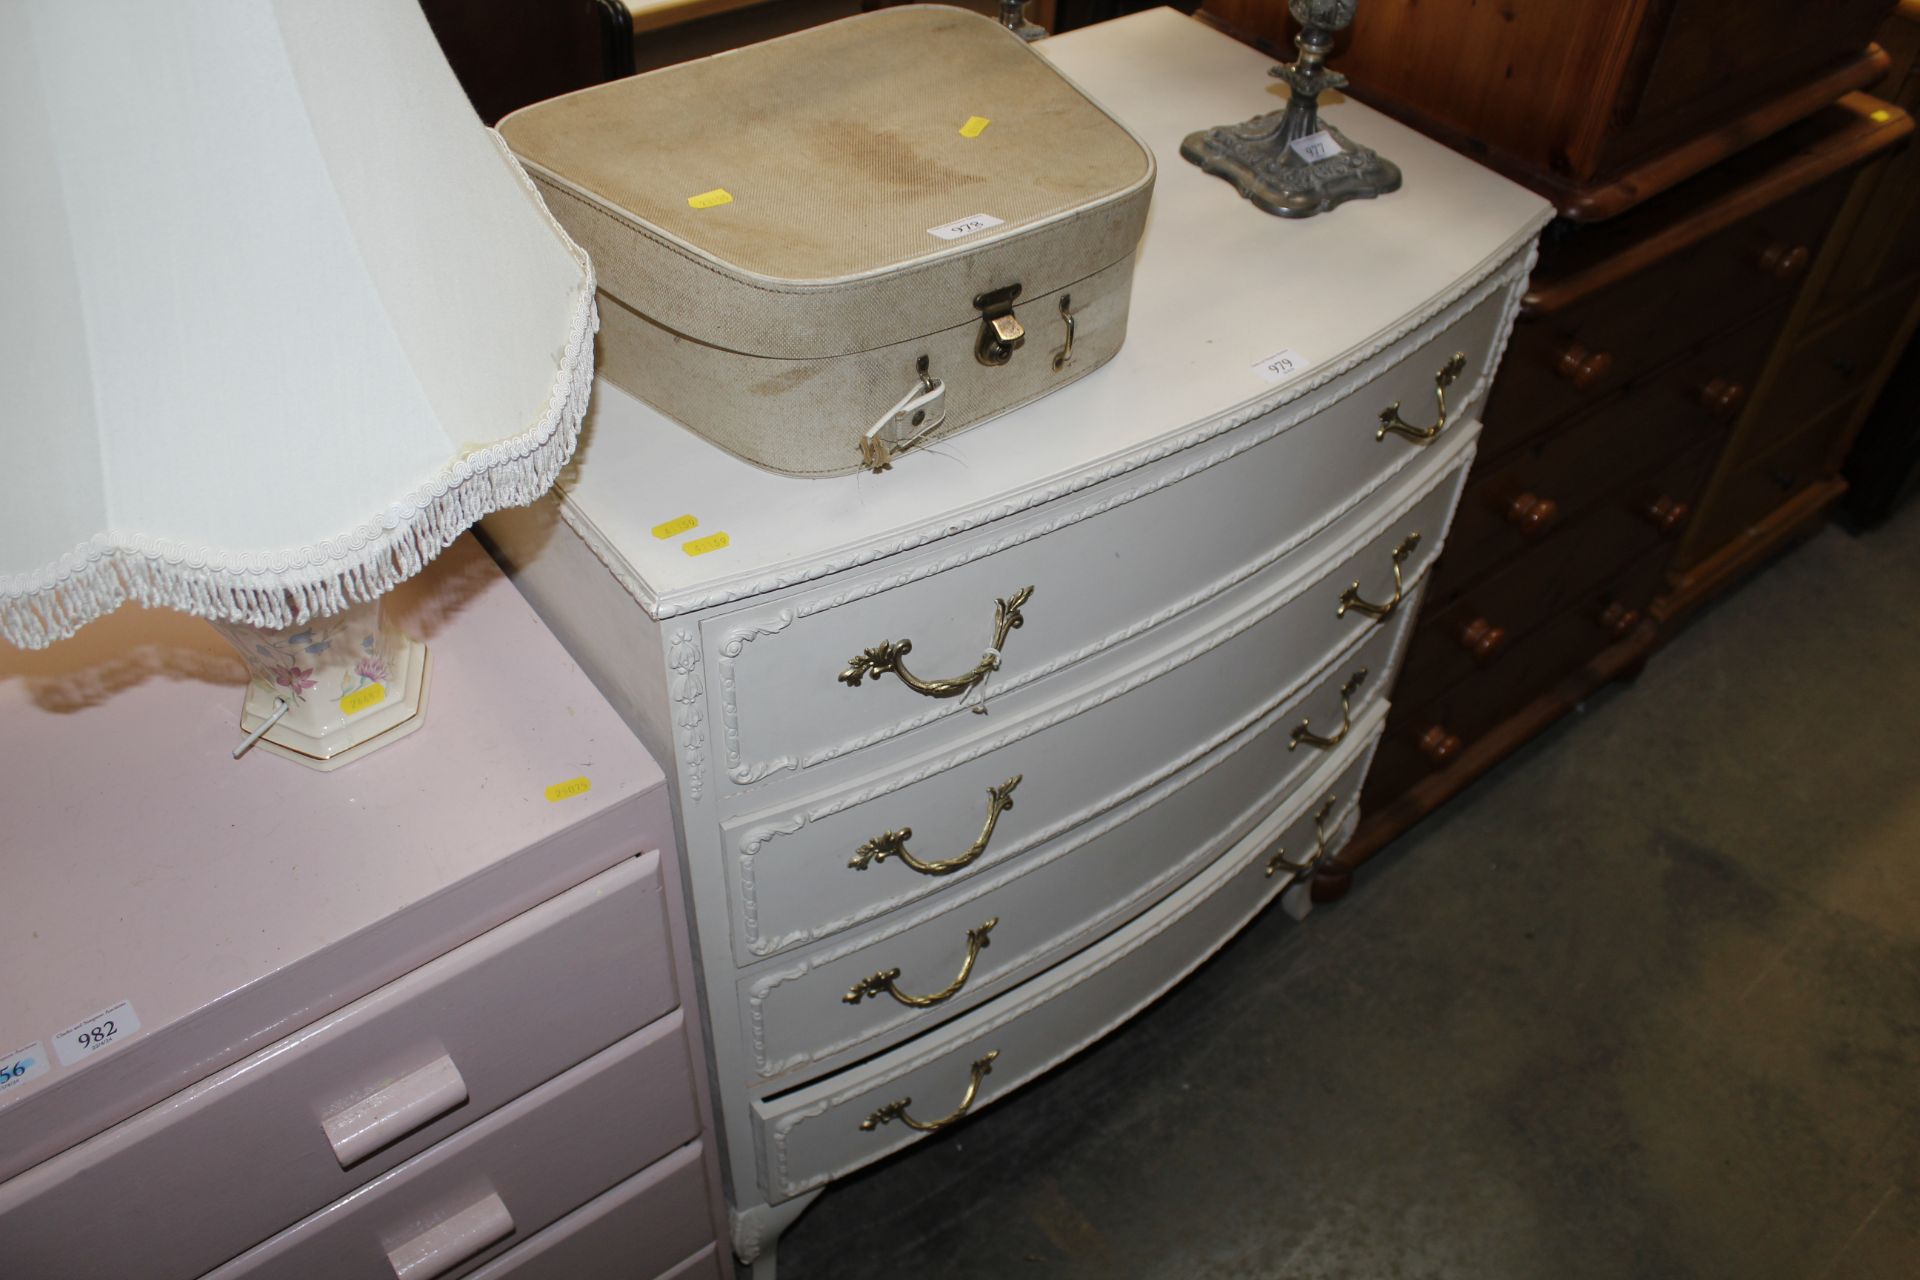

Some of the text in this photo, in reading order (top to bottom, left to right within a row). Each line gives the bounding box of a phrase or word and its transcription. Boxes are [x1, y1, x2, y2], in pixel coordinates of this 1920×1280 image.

[1305, 143, 1325, 157] 977
[951, 220, 984, 233] 978
[1268, 358, 1293, 374] 979
[78, 1020, 118, 1049] 982
